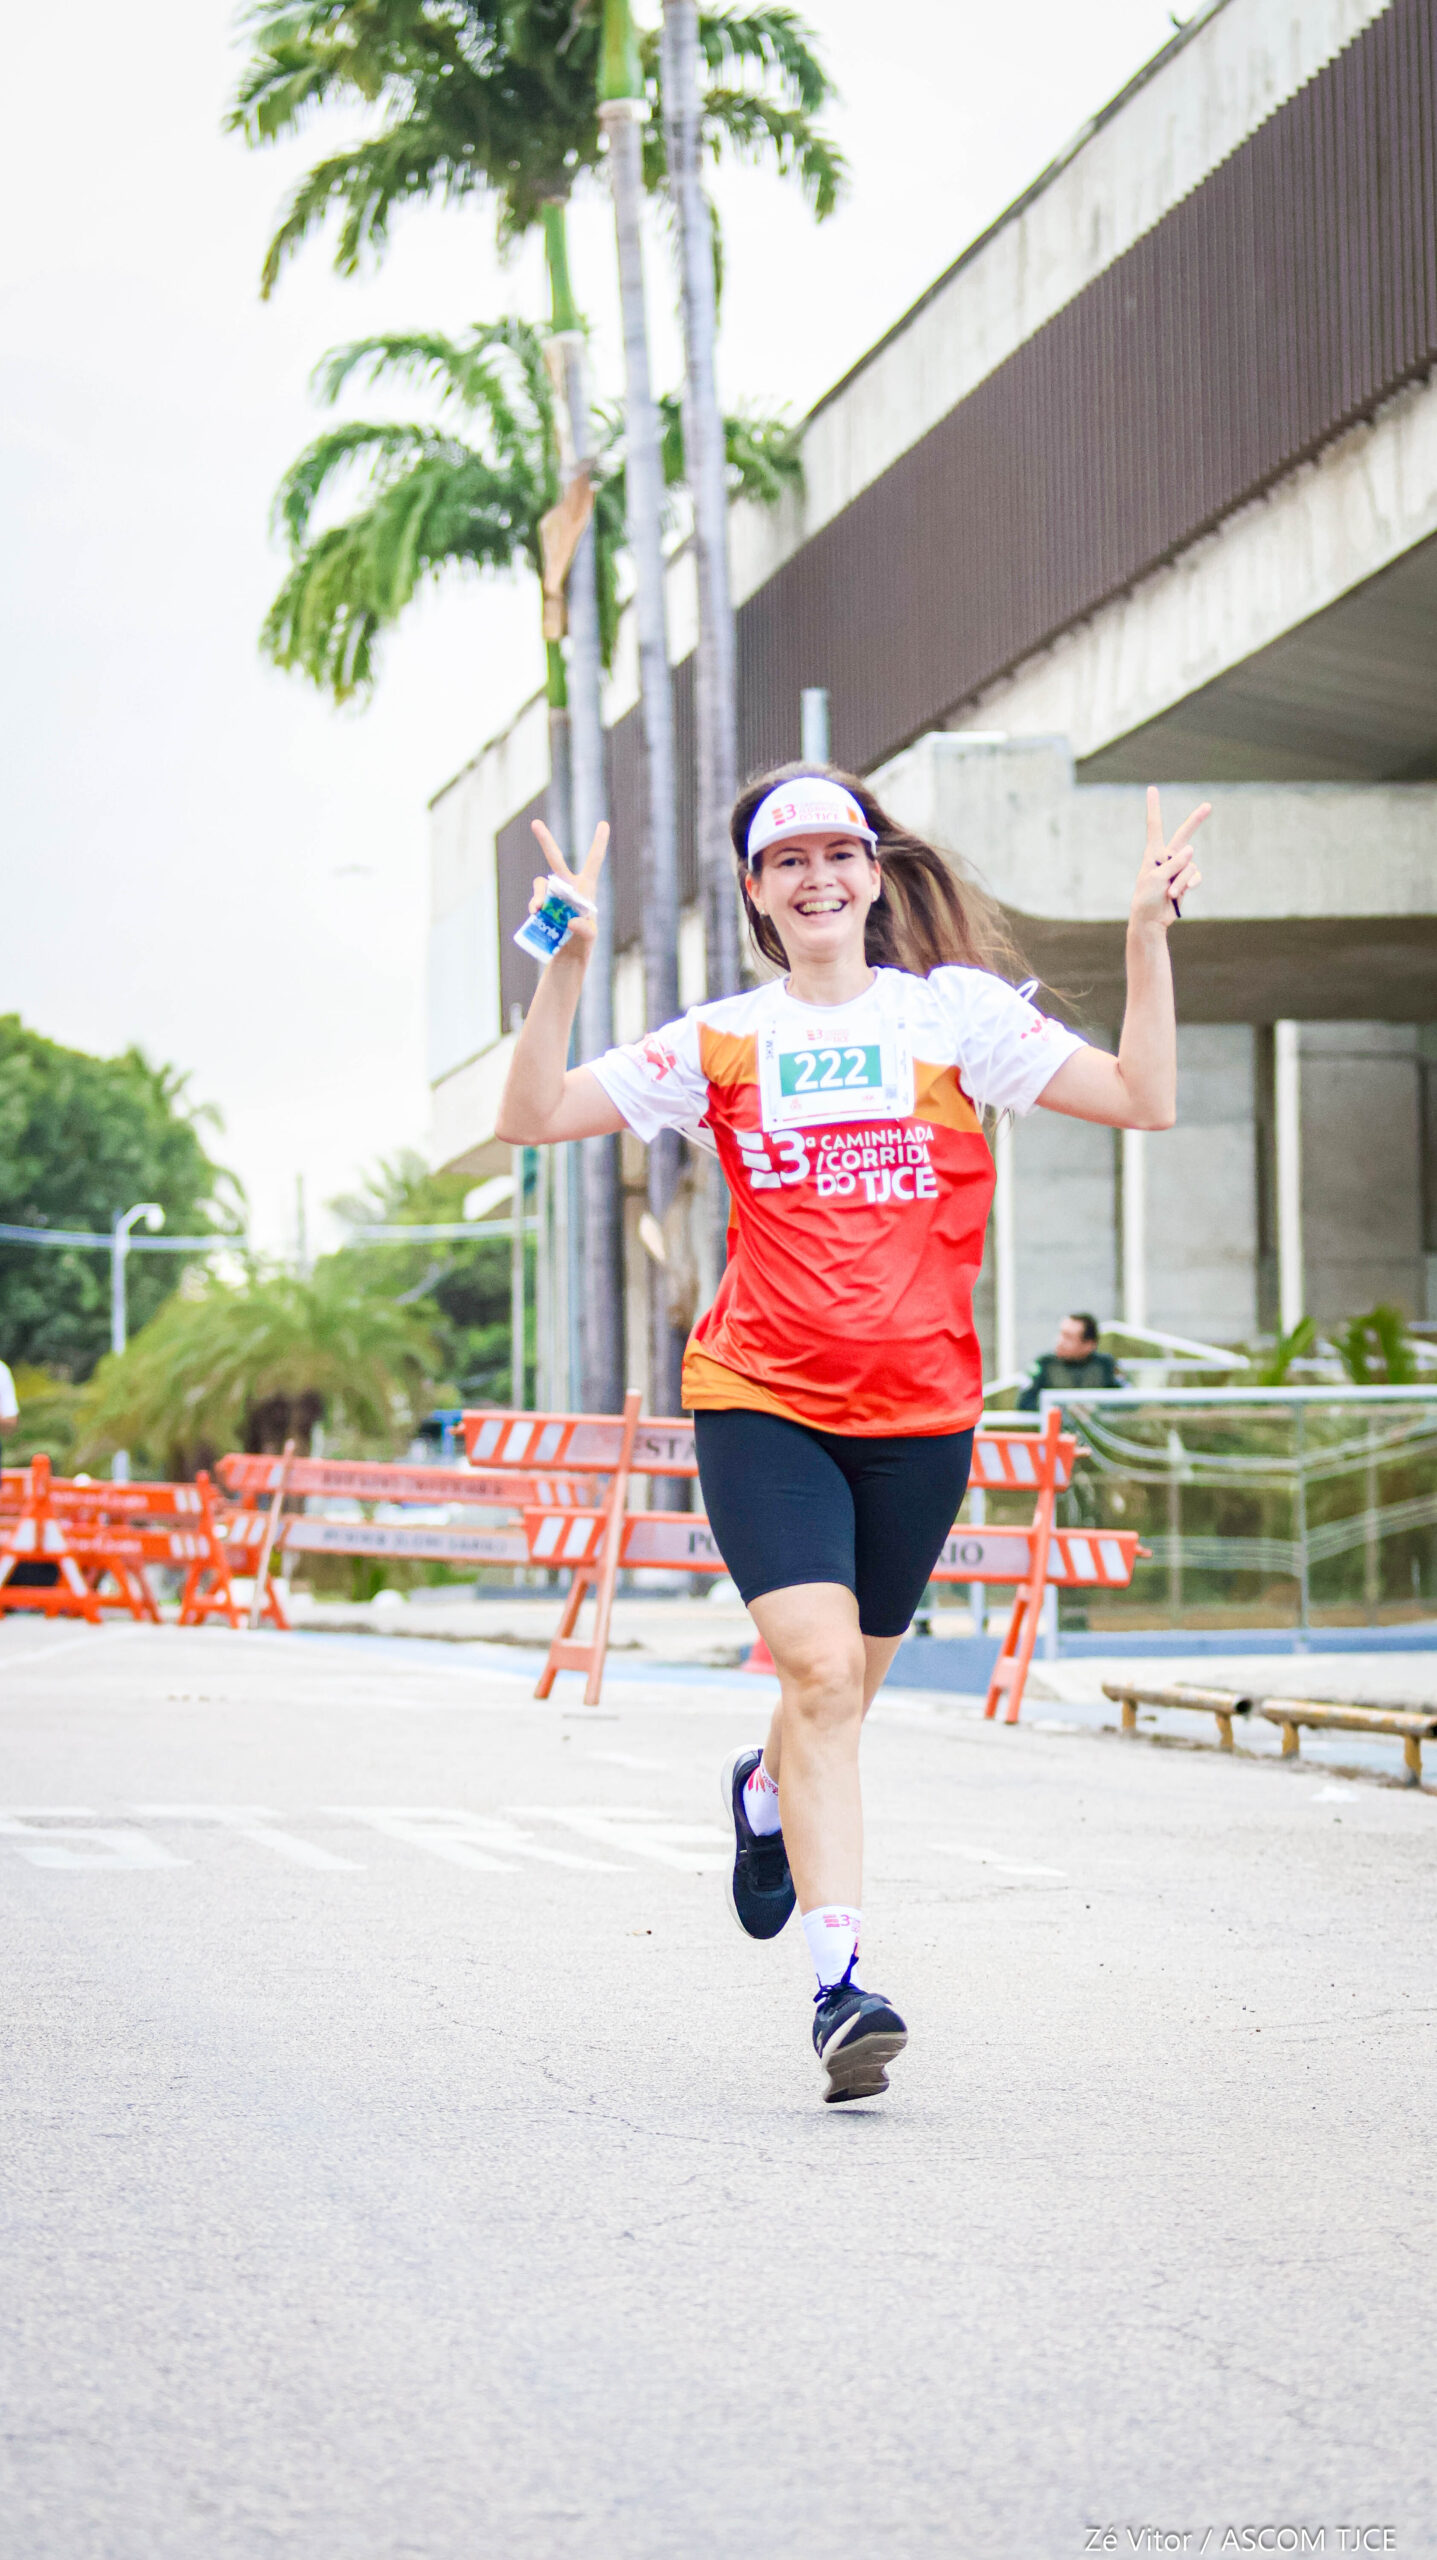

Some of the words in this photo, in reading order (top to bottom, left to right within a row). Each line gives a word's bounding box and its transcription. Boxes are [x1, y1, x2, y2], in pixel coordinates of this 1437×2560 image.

[793, 1047, 869, 1092] 222
[820, 1125, 935, 1151] CAMINHADA
[816, 1171, 856, 1197] DO
[858, 1165, 939, 1203] TJCE
[937, 1540, 984, 1565] IO
